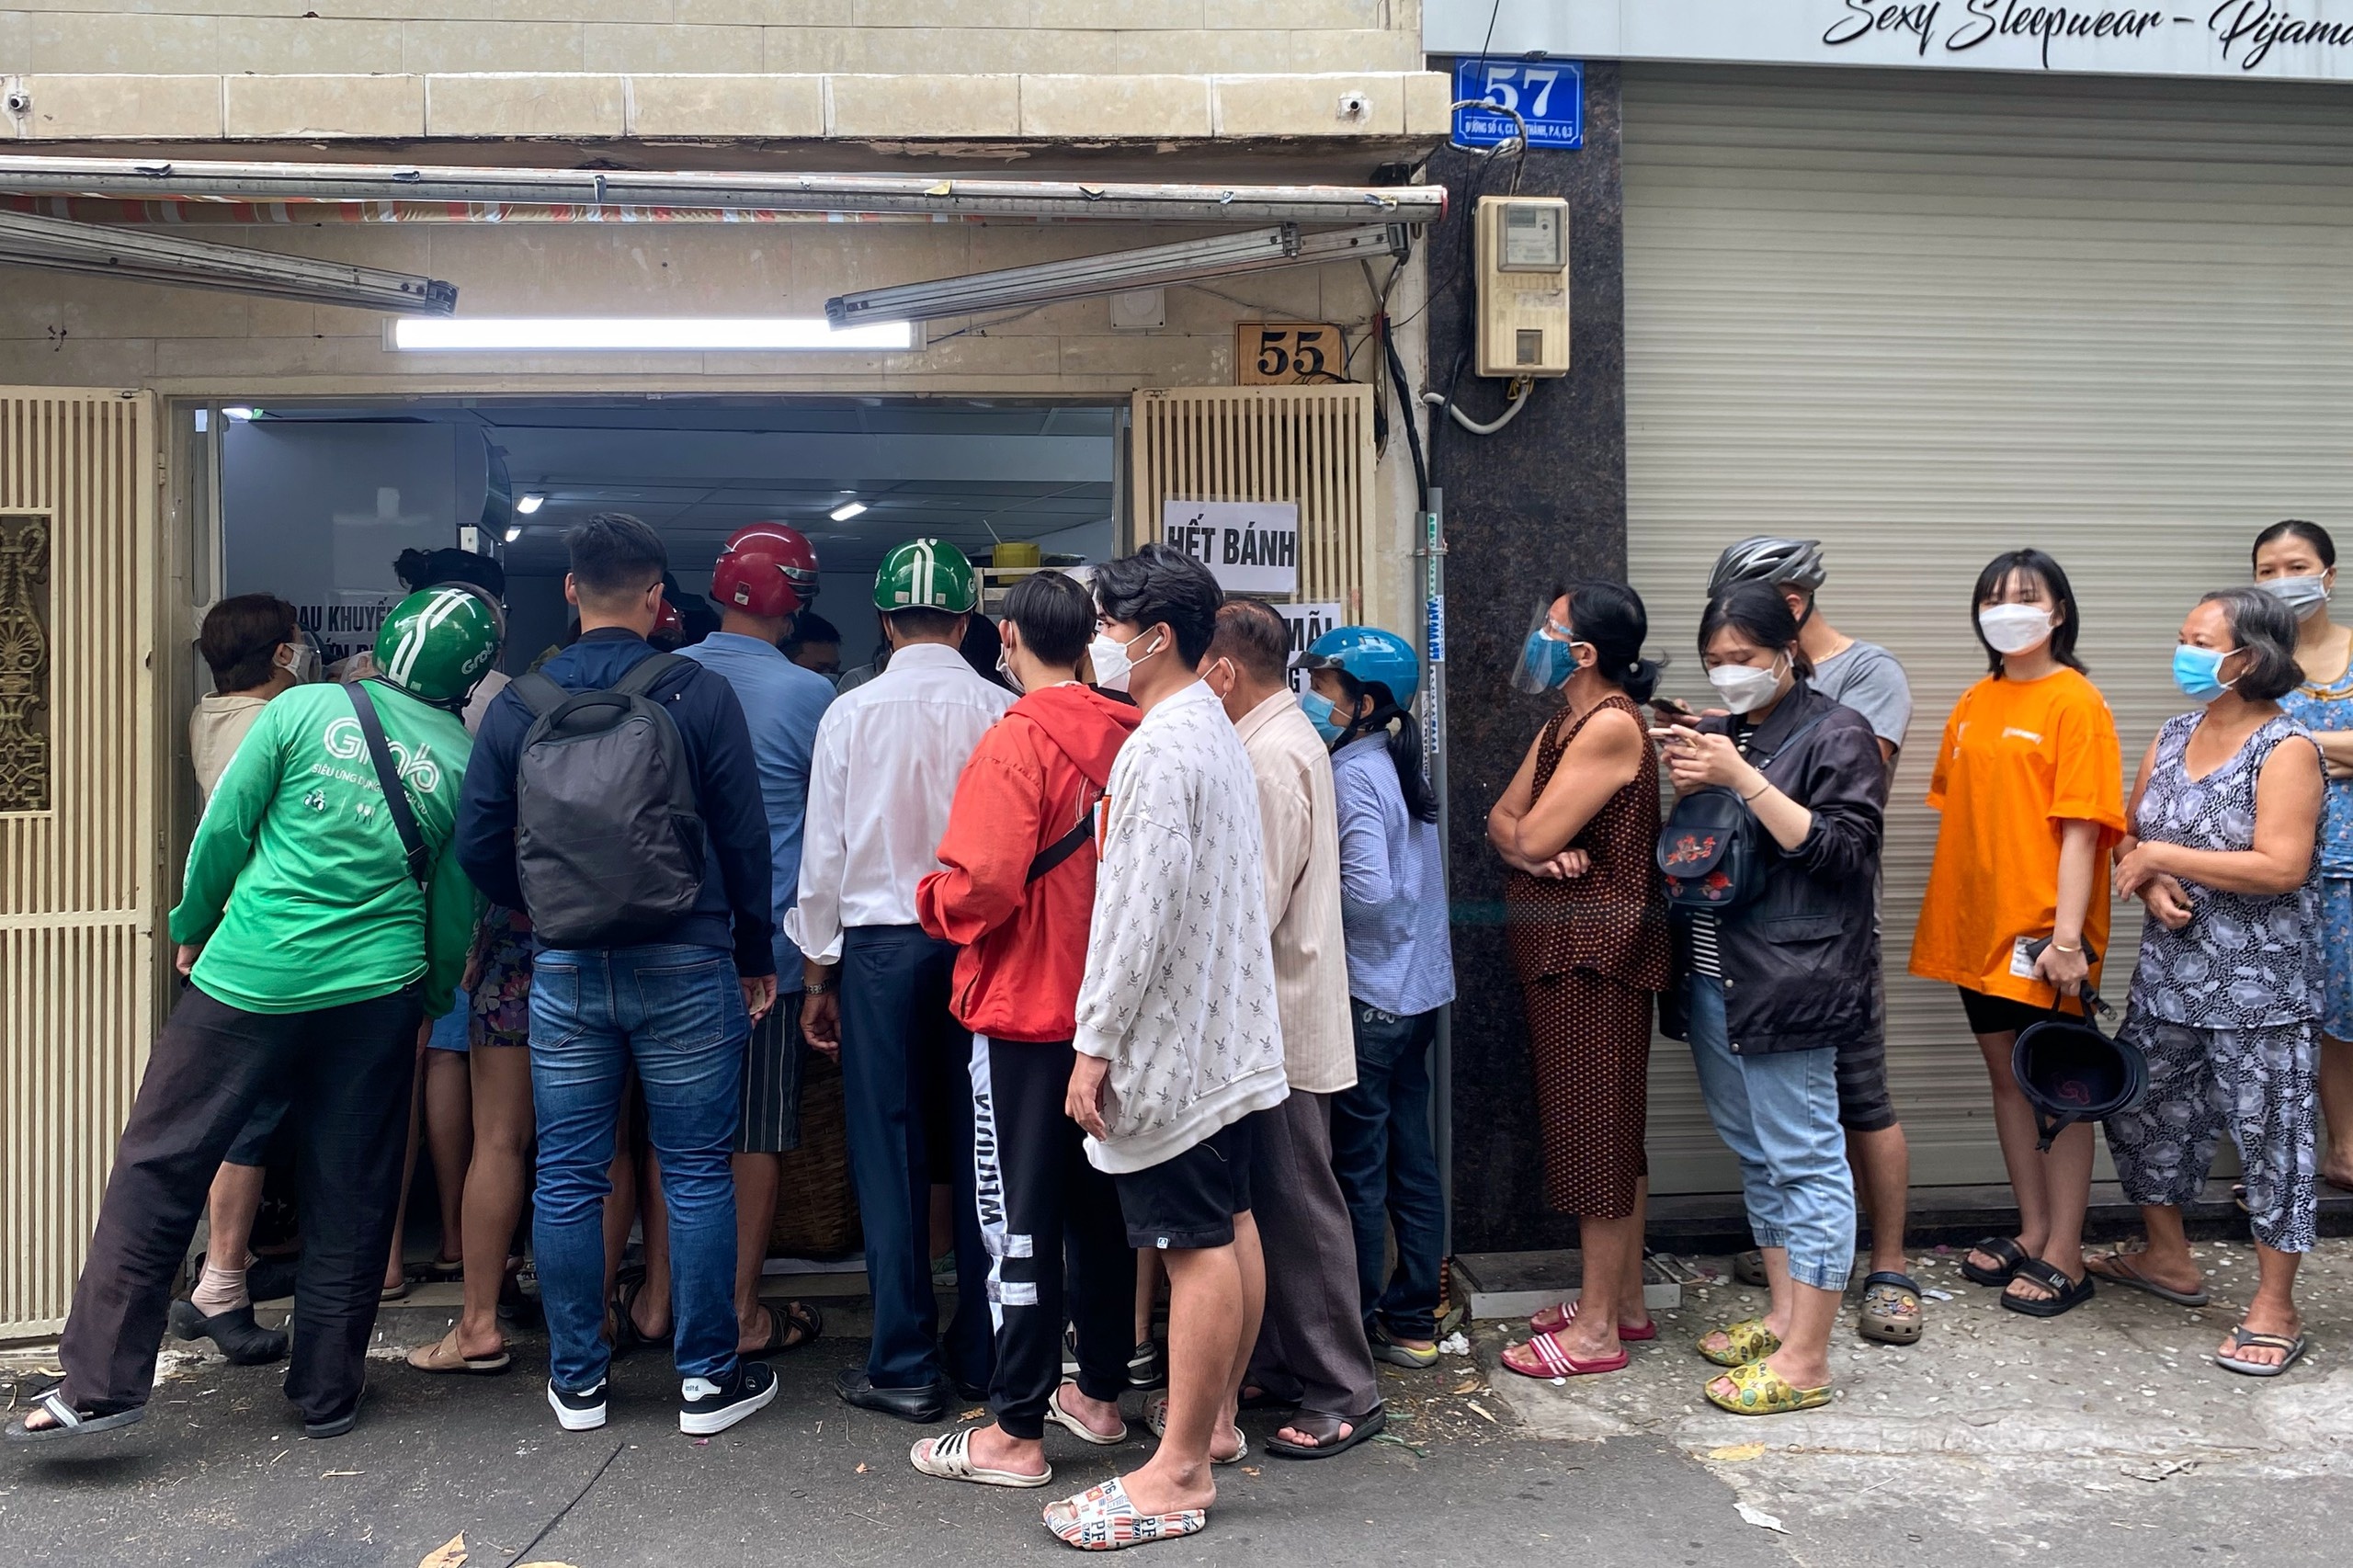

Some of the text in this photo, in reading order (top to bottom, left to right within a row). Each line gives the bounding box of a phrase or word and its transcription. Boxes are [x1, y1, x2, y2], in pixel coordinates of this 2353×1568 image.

[1823, 0, 1944, 56] Sexy
[1945, 0, 2163, 69] Sleepwear
[1483, 67, 1559, 118] 57
[1257, 331, 1324, 377] 55
[1168, 514, 1296, 567] HẾT BÁNH
[461, 641, 494, 676] Grab
[312, 763, 333, 778] SIÊU
[335, 767, 357, 783] ỨNG
